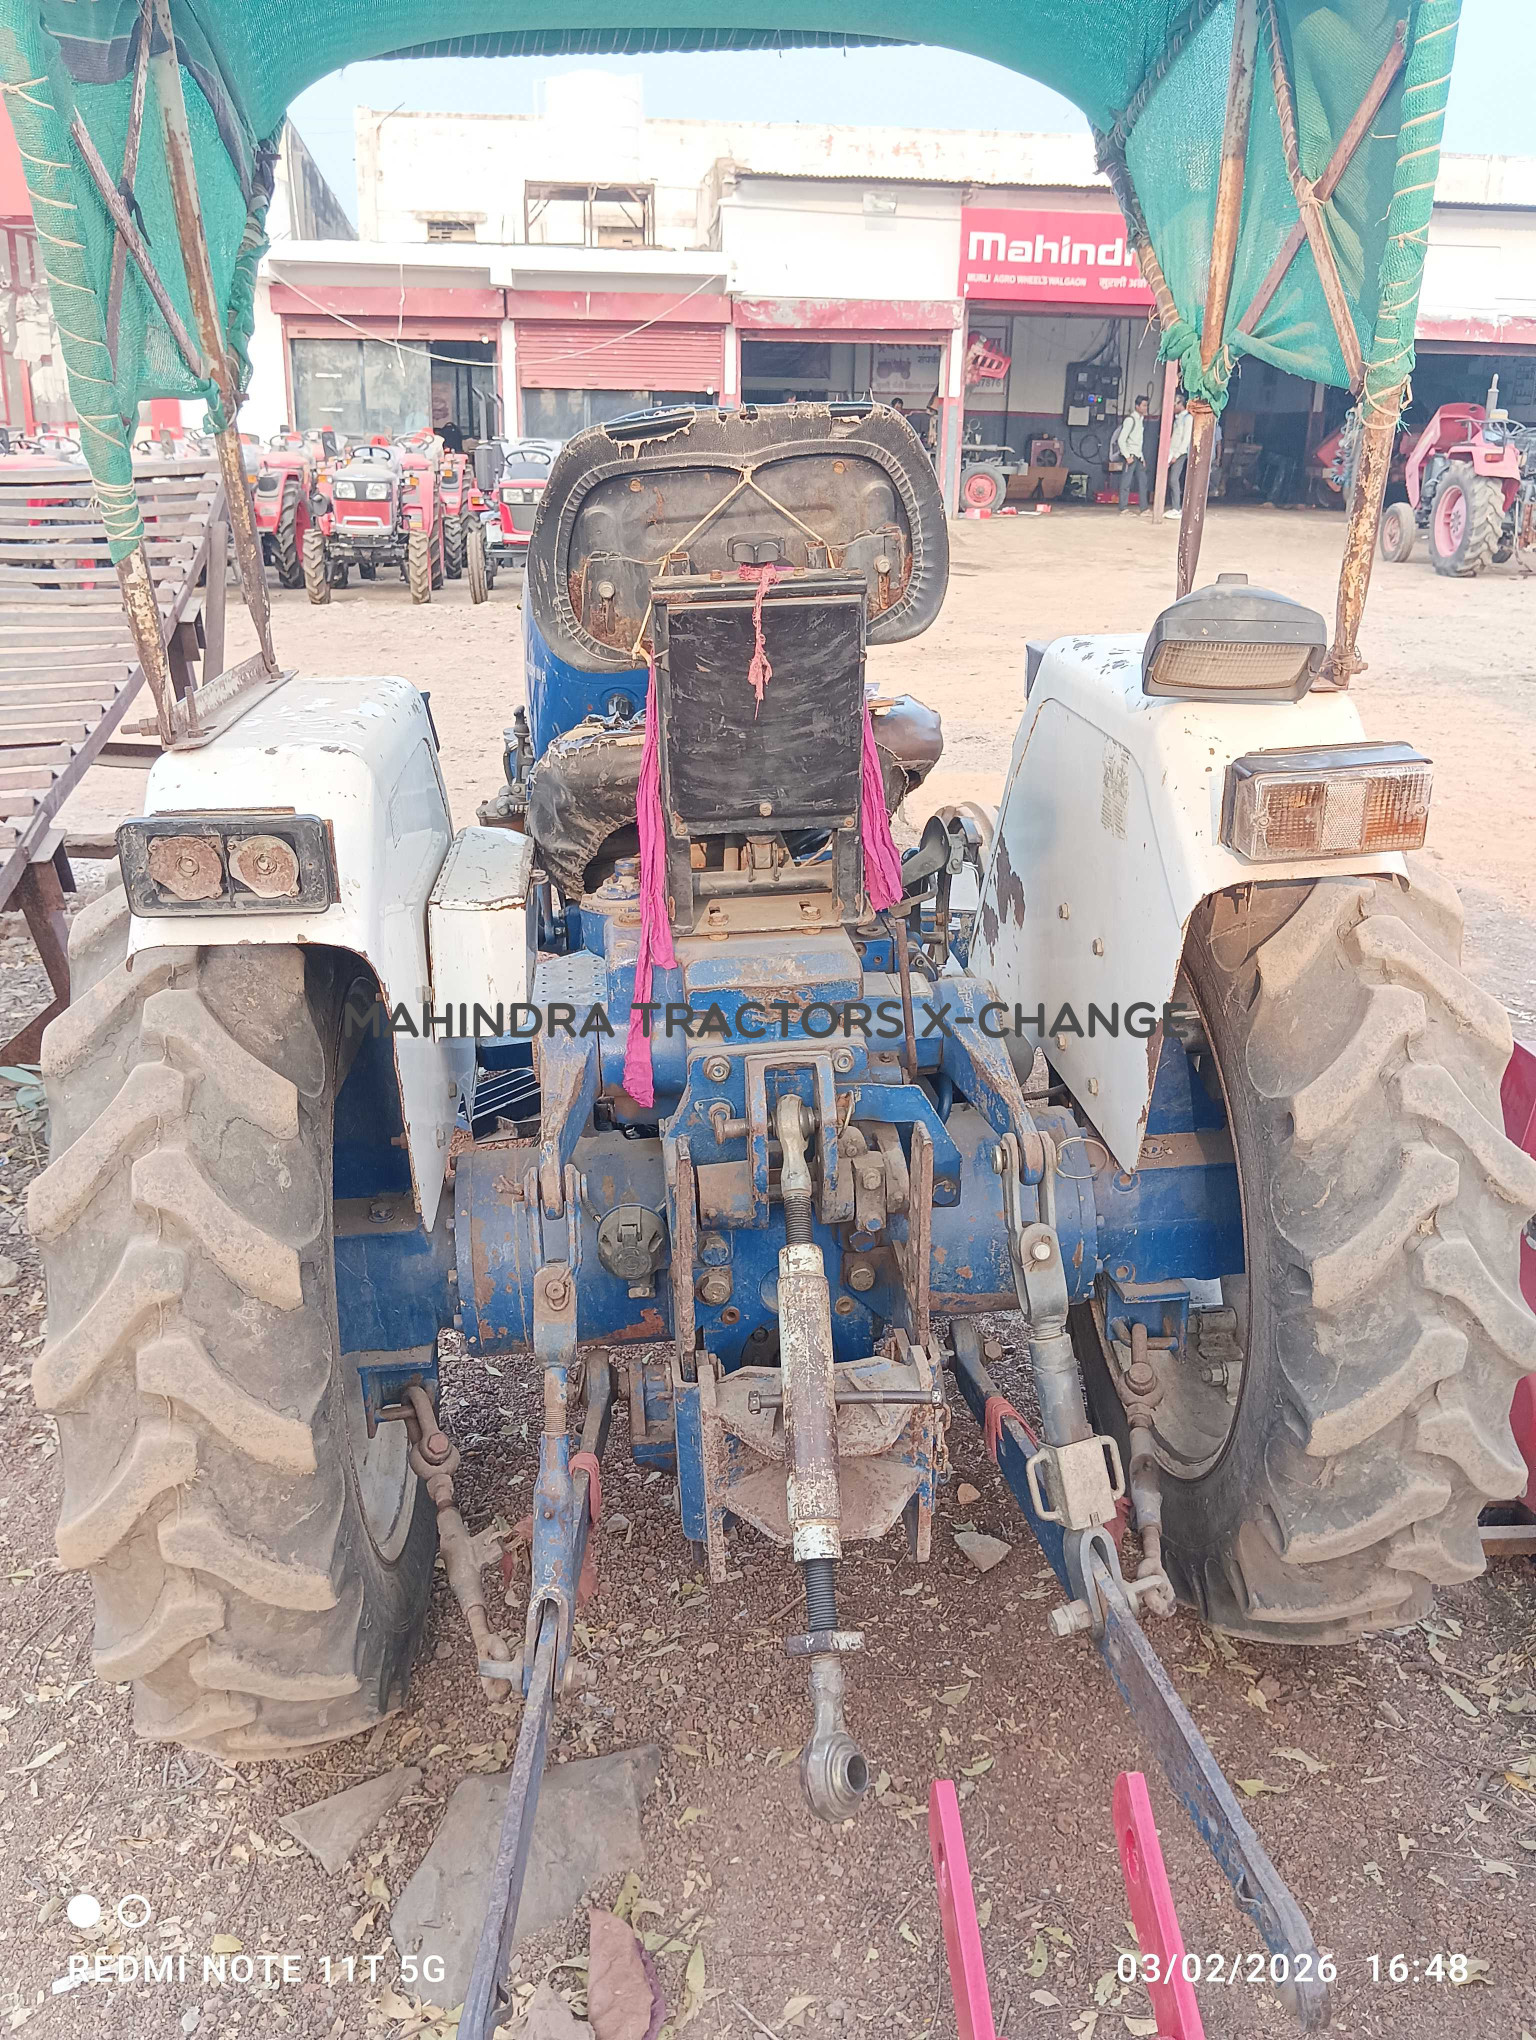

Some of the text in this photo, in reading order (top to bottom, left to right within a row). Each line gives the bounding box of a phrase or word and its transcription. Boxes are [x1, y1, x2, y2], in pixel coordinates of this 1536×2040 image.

[967, 231, 1136, 267] Mahindr
[966, 273, 991, 283] MURLI
[993, 274, 1016, 284] AGRO
